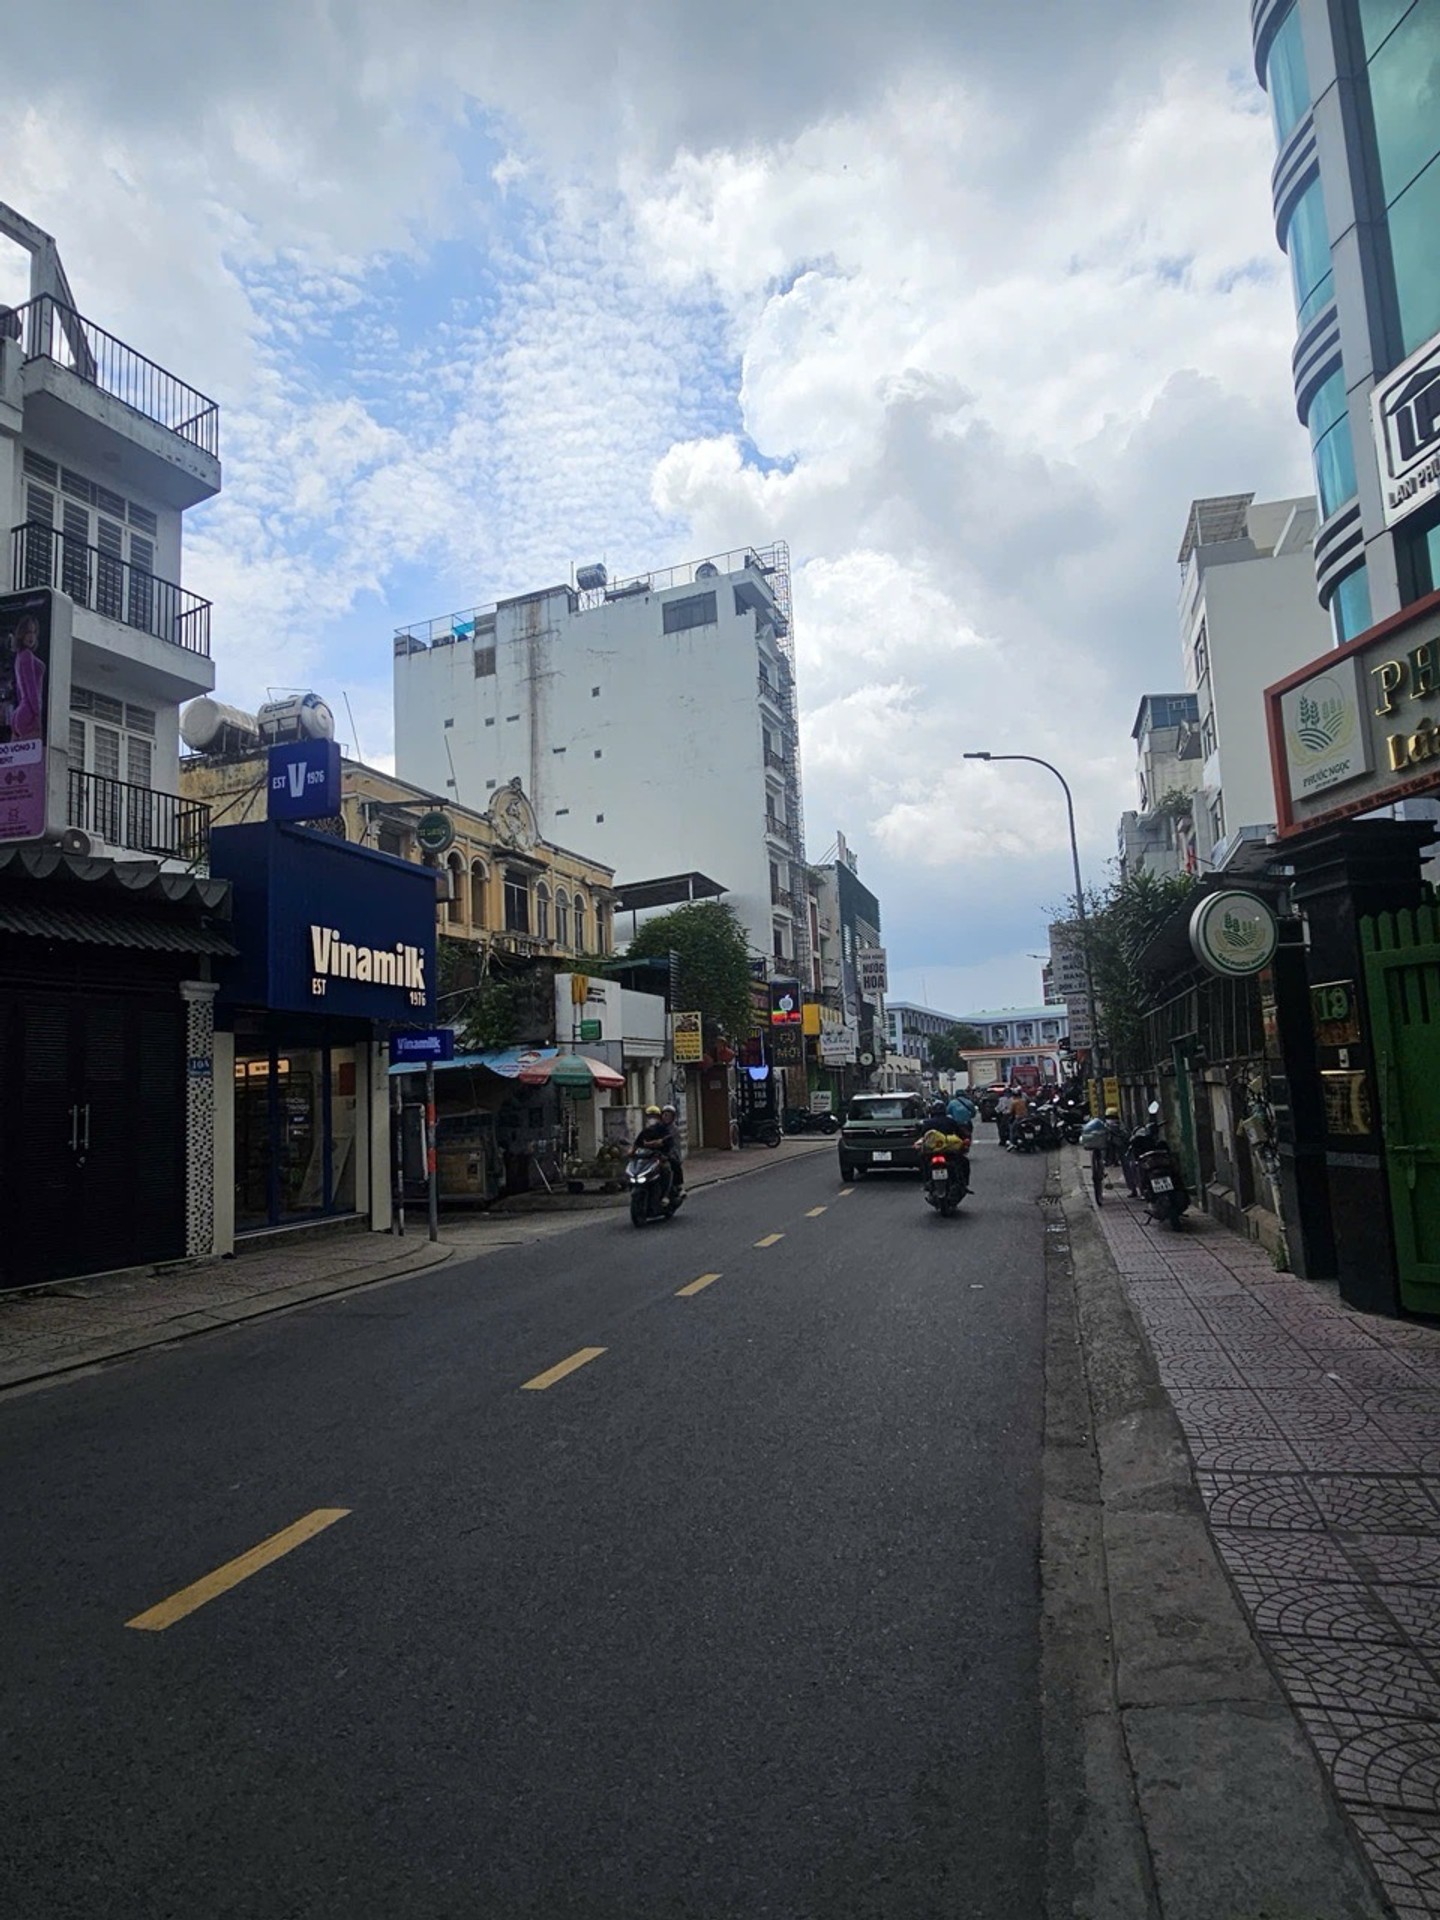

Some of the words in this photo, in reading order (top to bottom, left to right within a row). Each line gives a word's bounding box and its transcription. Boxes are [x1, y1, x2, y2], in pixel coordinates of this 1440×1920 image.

[272, 775, 286, 789] EST
[287, 761, 307, 798] V
[306, 769, 325, 784] 1976
[310, 925, 426, 990] Vinamilk
[312, 978, 327, 996] EST
[863, 975, 885, 989] HOA
[409, 990, 427, 1007] 1976
[1317, 986, 1349, 1020] 19
[397, 1036, 441, 1050] Vinamilk
